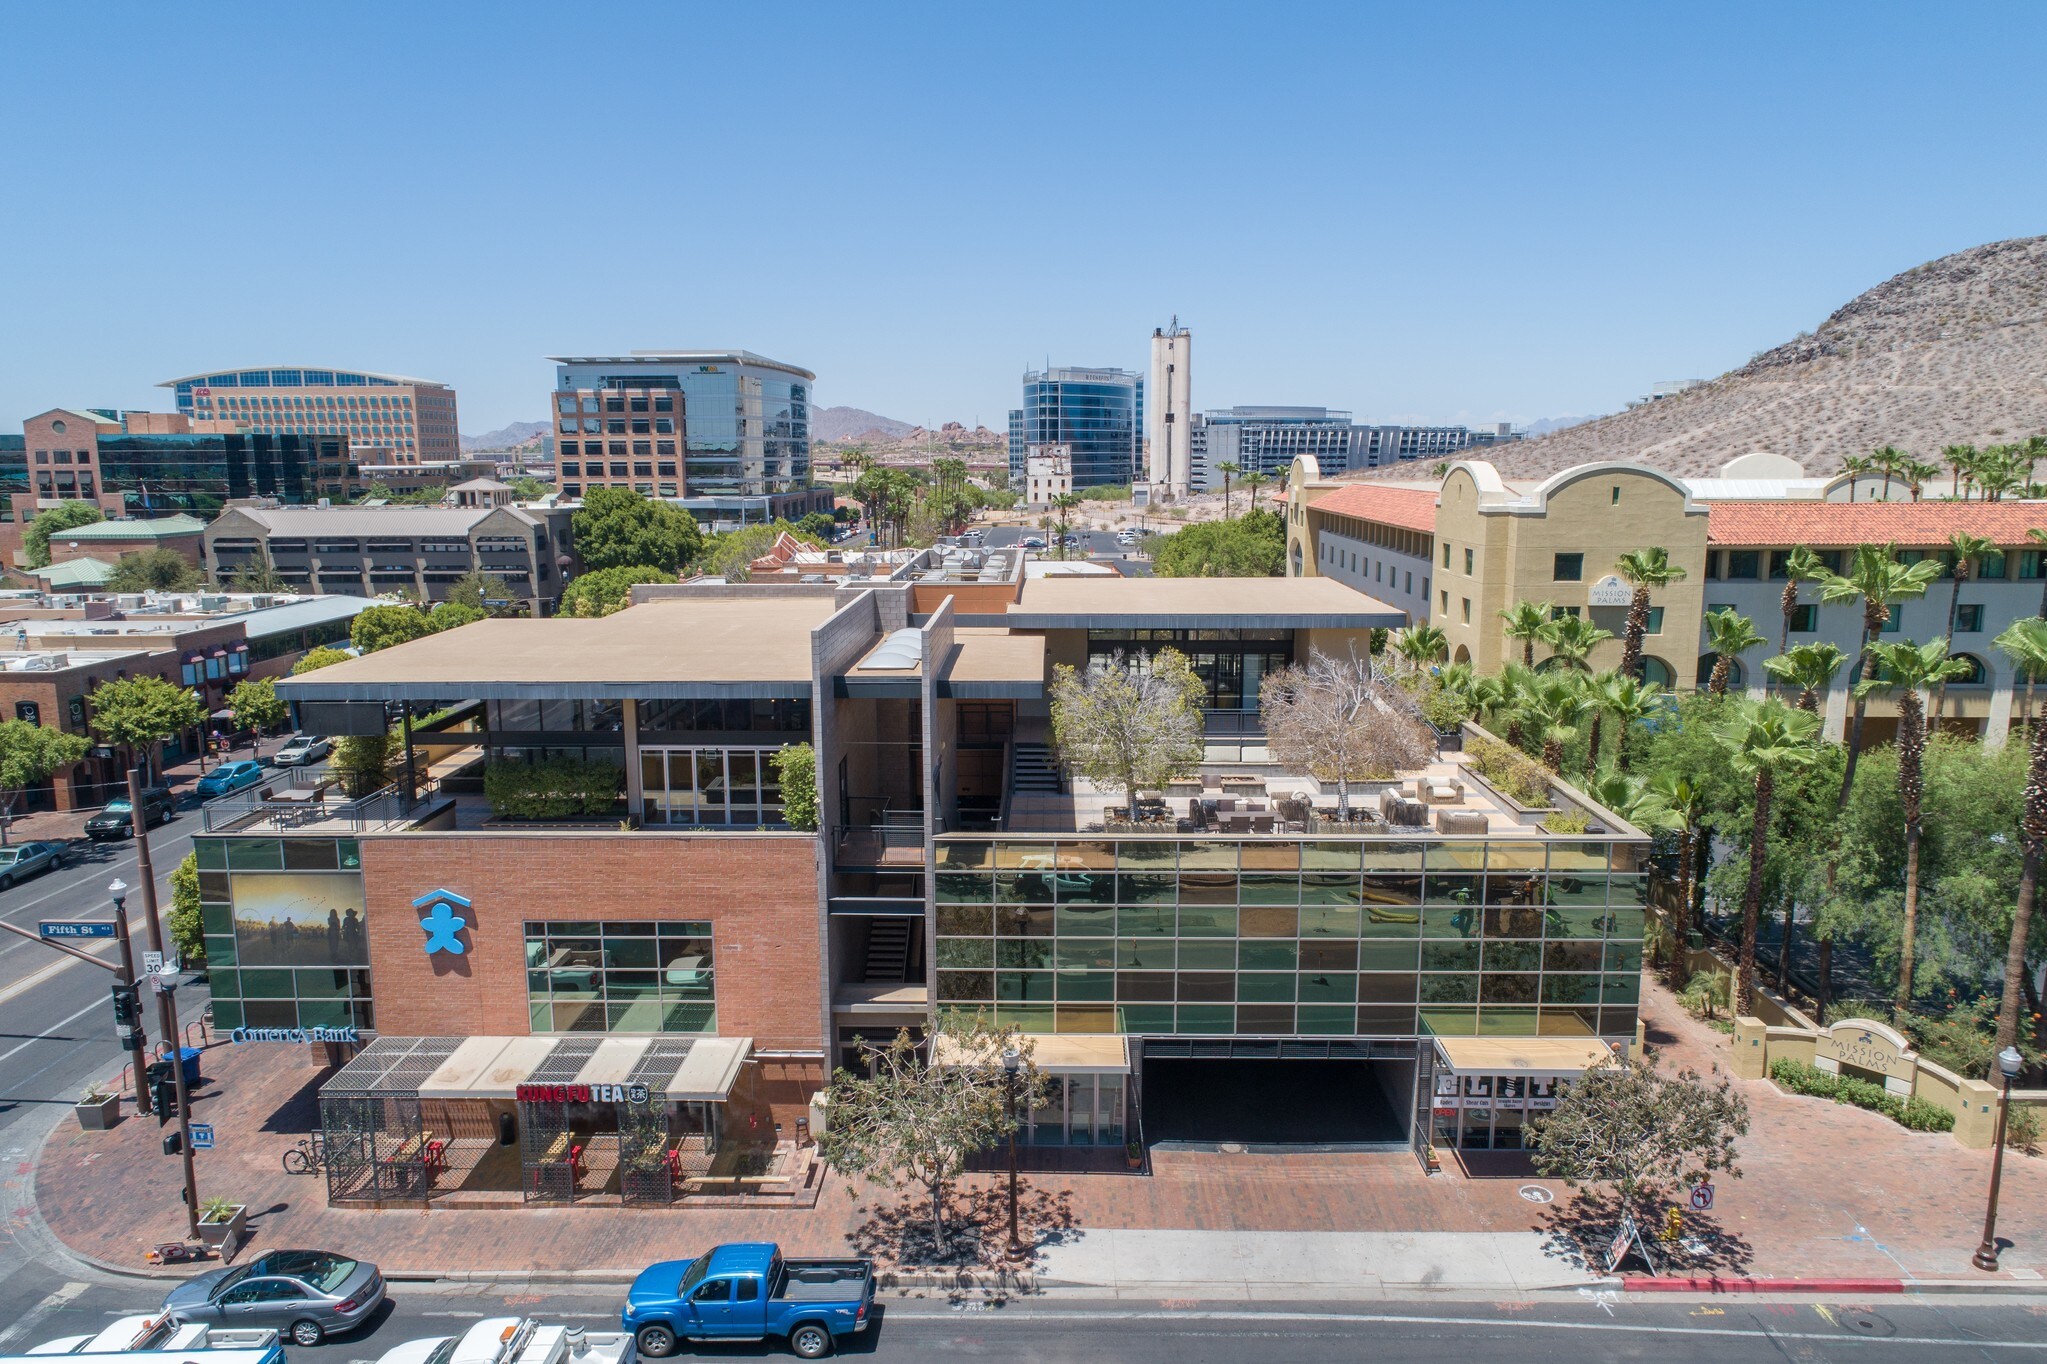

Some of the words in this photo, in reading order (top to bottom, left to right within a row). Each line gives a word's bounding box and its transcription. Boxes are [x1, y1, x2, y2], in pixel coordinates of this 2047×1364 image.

[48, 925, 77, 934] Fifth
[81, 925, 94, 934] St
[146, 964, 161, 973] 30
[312, 1026, 357, 1043] Bank
[1831, 1040, 1897, 1065] MISSION
[1839, 1051, 1888, 1072] PALMS
[516, 1084, 566, 1103] KUNG
[567, 1084, 589, 1103] FU
[590, 1084, 625, 1103] TEA
